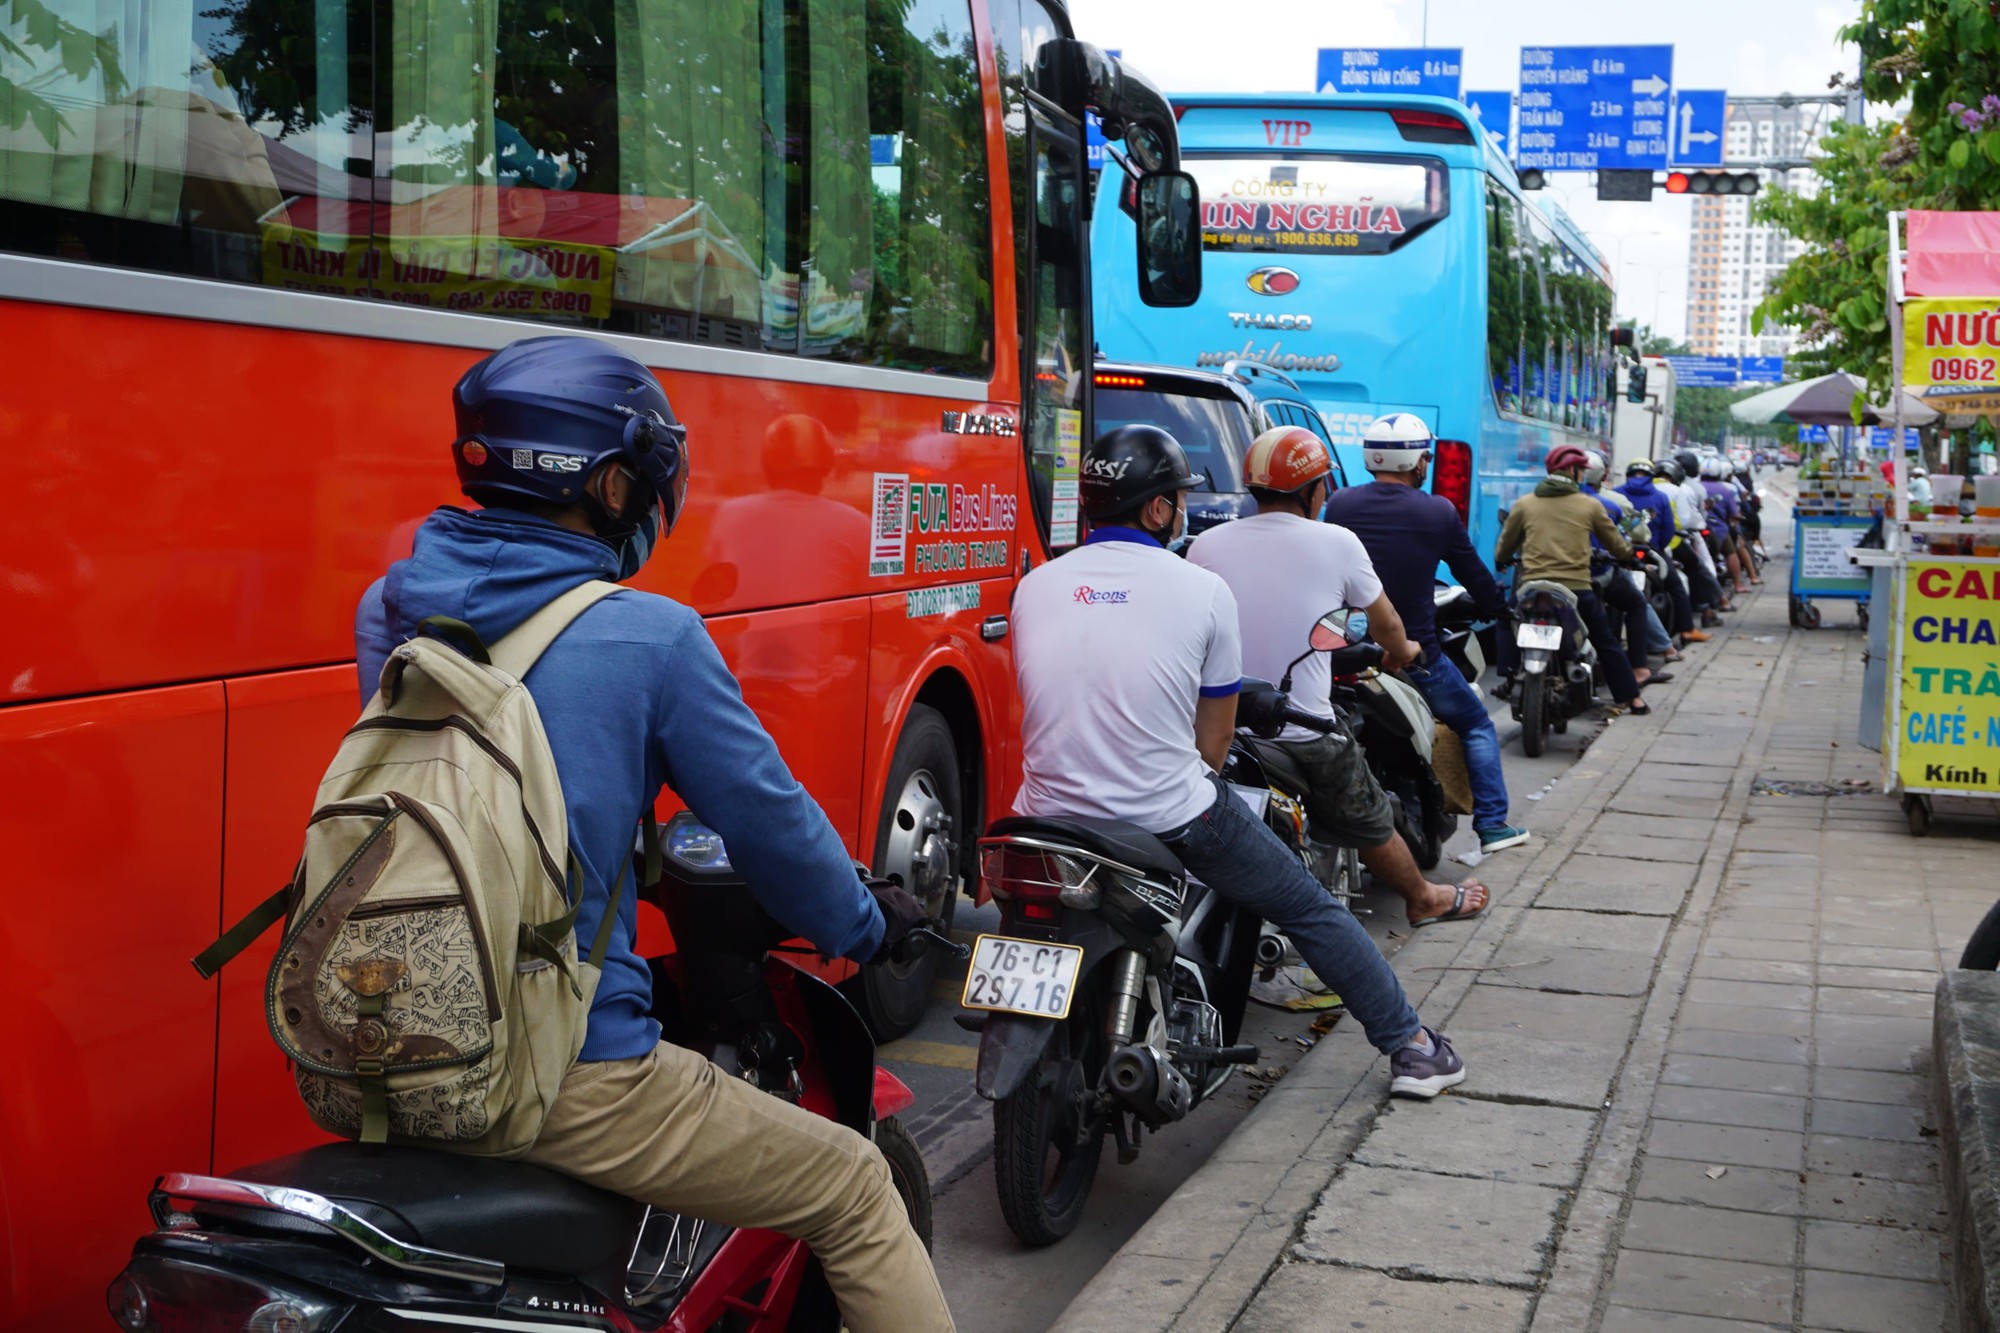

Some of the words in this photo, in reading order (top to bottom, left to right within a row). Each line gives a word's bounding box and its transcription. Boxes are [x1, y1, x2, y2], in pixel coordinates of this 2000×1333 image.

[1442, 60, 1459, 76] km
[1609, 59, 1625, 75] km
[1607, 101, 1623, 117] km
[1262, 119, 1312, 146] VIP
[1604, 132, 1620, 148] km
[1231, 177, 1294, 197] CÔNG
[1302, 181, 1328, 197] TY
[1266, 196, 1405, 233] NGHĨA
[1274, 231, 1358, 247] 1900.636.636
[1228, 312, 1312, 331] THACO
[1931, 357, 1996, 382] 0962
[907, 482, 951, 533] FUTA
[951, 483, 981, 532] Bus
[980, 483, 1017, 532] Lines
[969, 540, 1007, 569] TRANG
[1917, 567, 2000, 601] CA
[1912, 615, 2000, 646] CHA
[1912, 662, 2000, 697] TRÀ
[1907, 705, 1967, 745] CAFÉ
[1925, 764, 1987, 785] Kính
[990, 941, 1064, 979] 76-C1
[970, 974, 1066, 1014] 297.16
